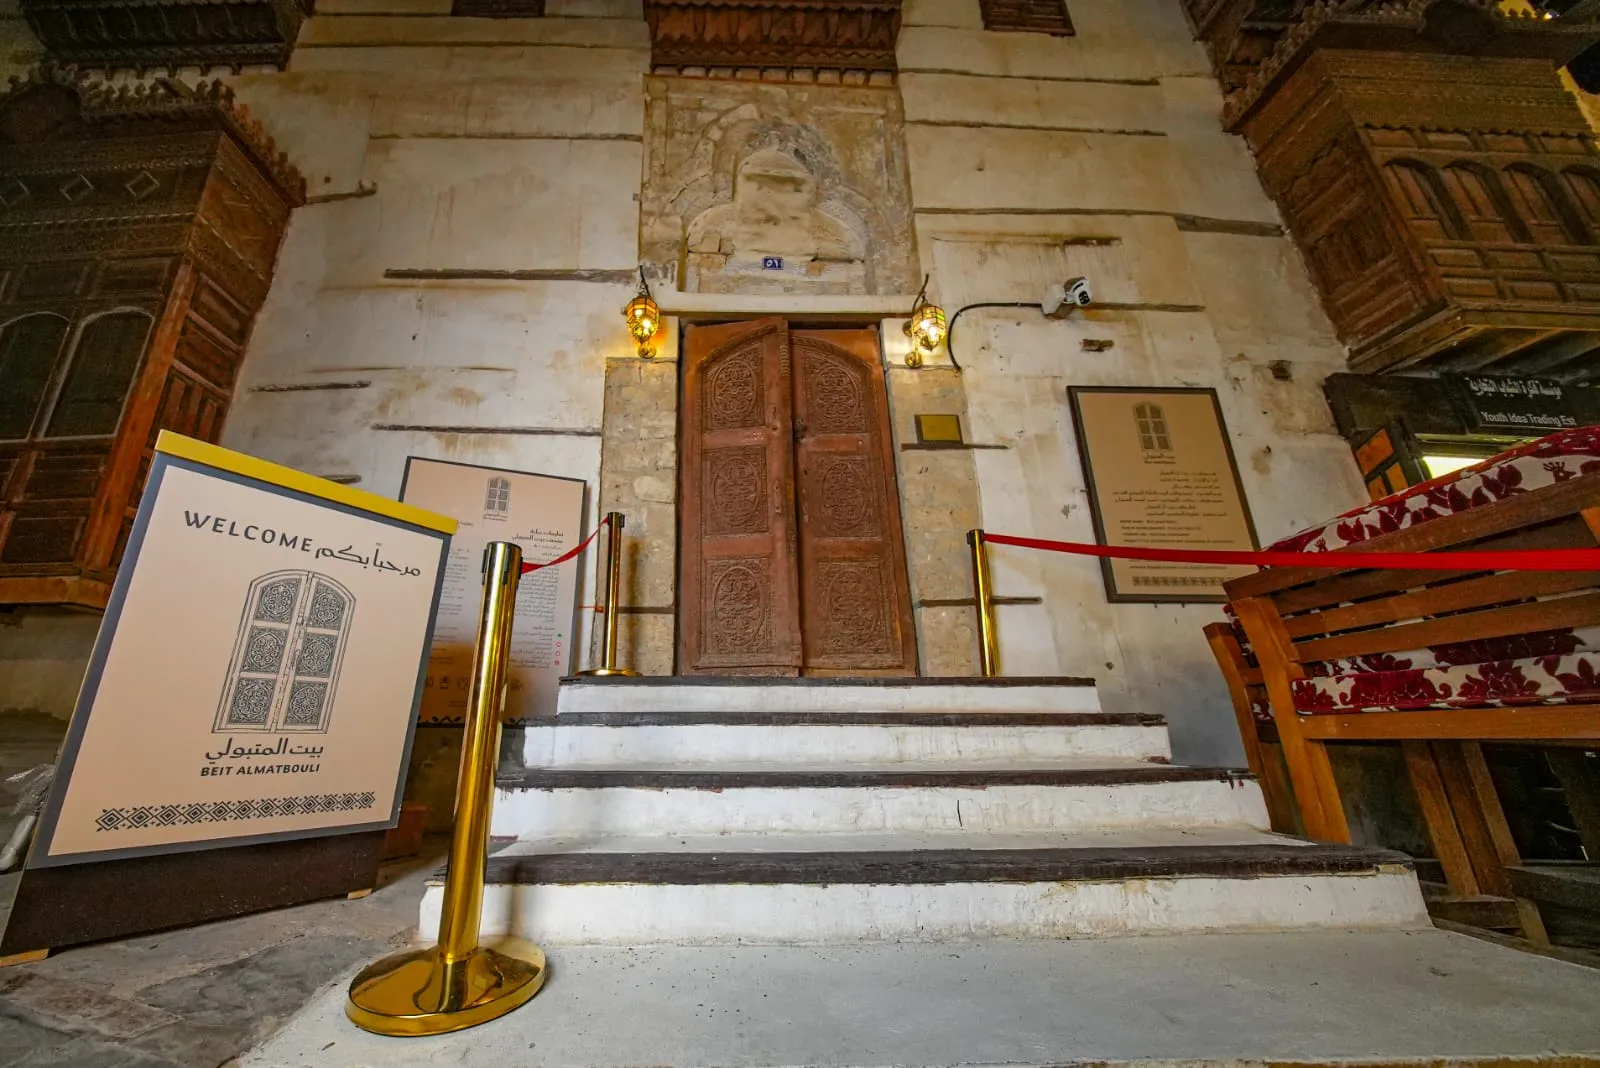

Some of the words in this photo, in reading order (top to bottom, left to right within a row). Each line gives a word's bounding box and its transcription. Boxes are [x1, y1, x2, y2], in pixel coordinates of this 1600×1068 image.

[1480, 411, 1508, 423] Youth
[1508, 412, 1528, 423] Idea
[1526, 413, 1561, 427] Trading
[1560, 415, 1577, 426] Est
[184, 510, 313, 553] WELCOME
[314, 545, 370, 569] بكم
[205, 737, 289, 765] المتبولي
[289, 744, 324, 758] بيت
[200, 766, 233, 777] BEIT
[236, 763, 321, 776] ALMATBOULI
